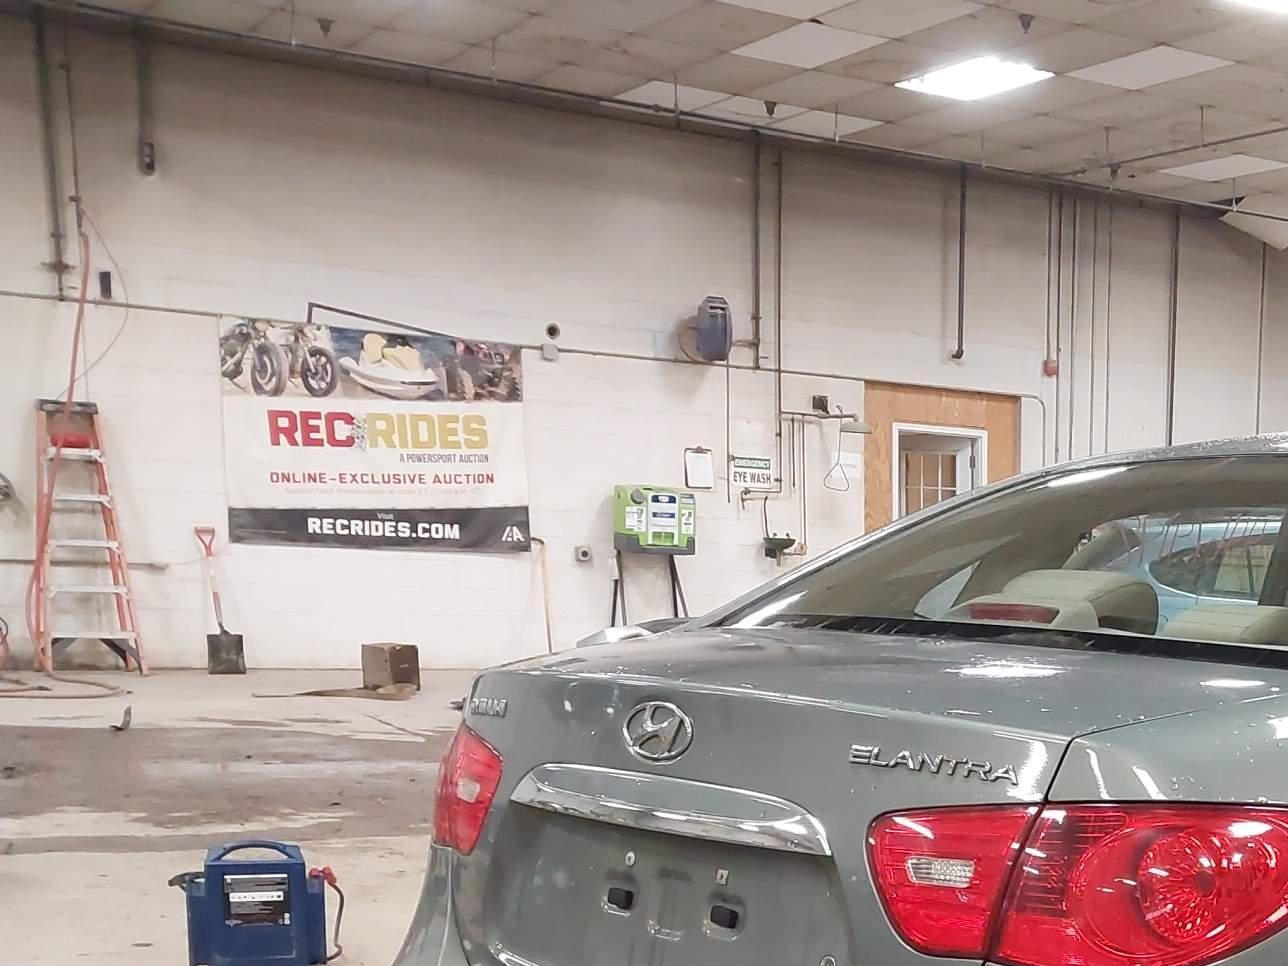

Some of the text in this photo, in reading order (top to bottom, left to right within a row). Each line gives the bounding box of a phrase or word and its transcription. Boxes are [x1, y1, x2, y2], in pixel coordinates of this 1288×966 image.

[267, 410, 489, 449] REC RIDES
[400, 453, 489, 464] A POWERSPORT AUCTION
[270, 471, 495, 485] ONLINE-EXCLUSIVE AUCTION
[733, 471, 771, 484] EYE WASH
[307, 517, 460, 540] RECRIDES.COM
[849, 744, 1019, 786] ELANTRA
